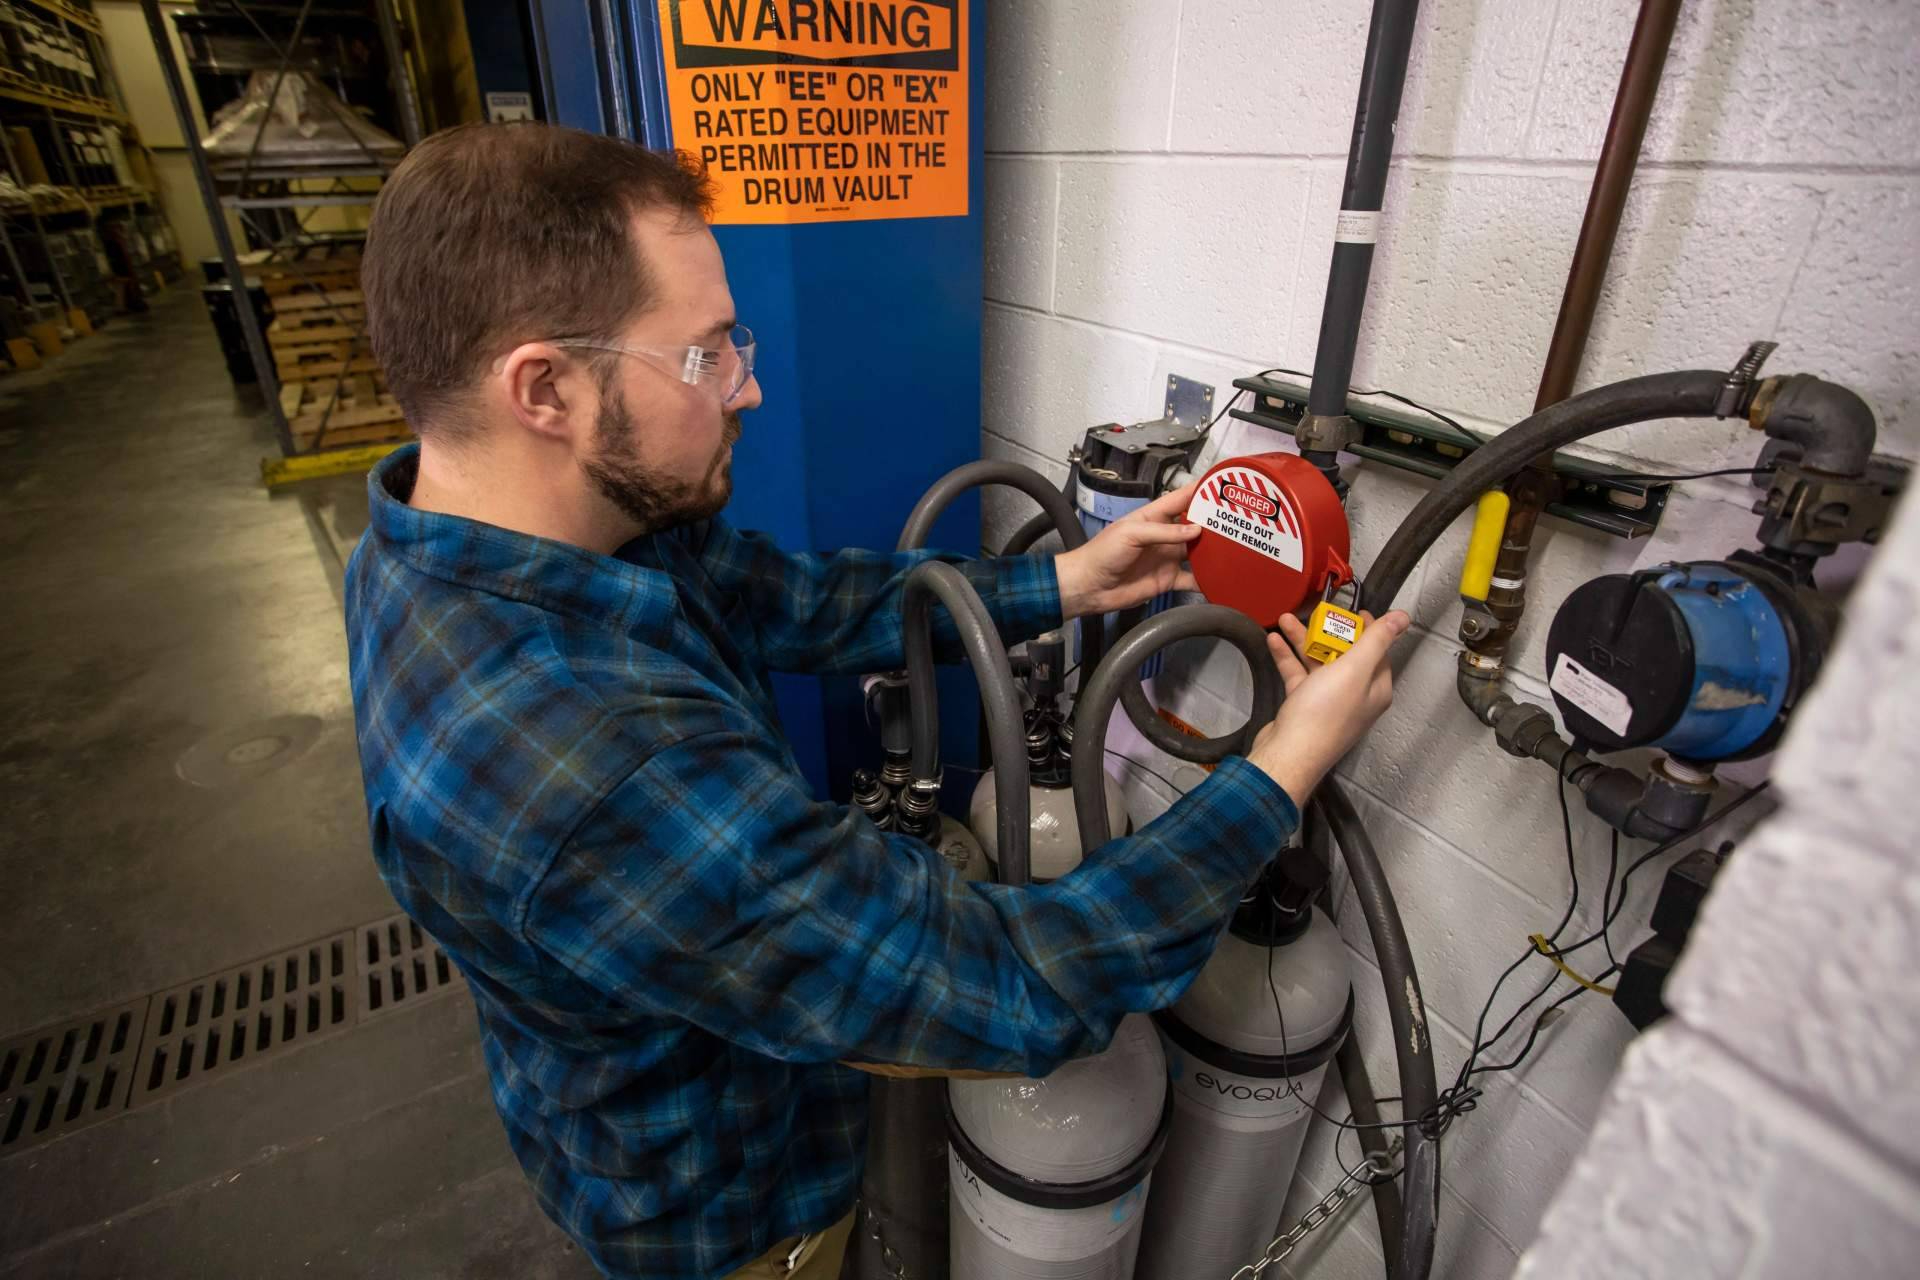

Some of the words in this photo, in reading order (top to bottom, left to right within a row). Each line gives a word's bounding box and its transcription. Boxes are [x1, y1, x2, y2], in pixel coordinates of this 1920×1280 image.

[704, 0, 931, 48] WARNING
[691, 71, 765, 103] ONLY
[775, 70, 837, 101] "EE"
[847, 72, 885, 102] OR
[893, 74, 949, 103] "EX"
[693, 108, 788, 138] RATED
[797, 107, 950, 136] EQUIPMENT
[701, 142, 859, 172] PERMITTED
[866, 142, 891, 169] IN
[898, 142, 947, 168] THE
[743, 176, 826, 205] DRUM
[832, 174, 913, 202] VAULT
[1228, 487, 1271, 514] DANGER
[1206, 517, 1220, 529] DO
[1220, 523, 1240, 539] NOT
[1241, 532, 1281, 558] REMOVE
[1216, 508, 1252, 531] LOCKED
[1253, 525, 1274, 541] OUT
